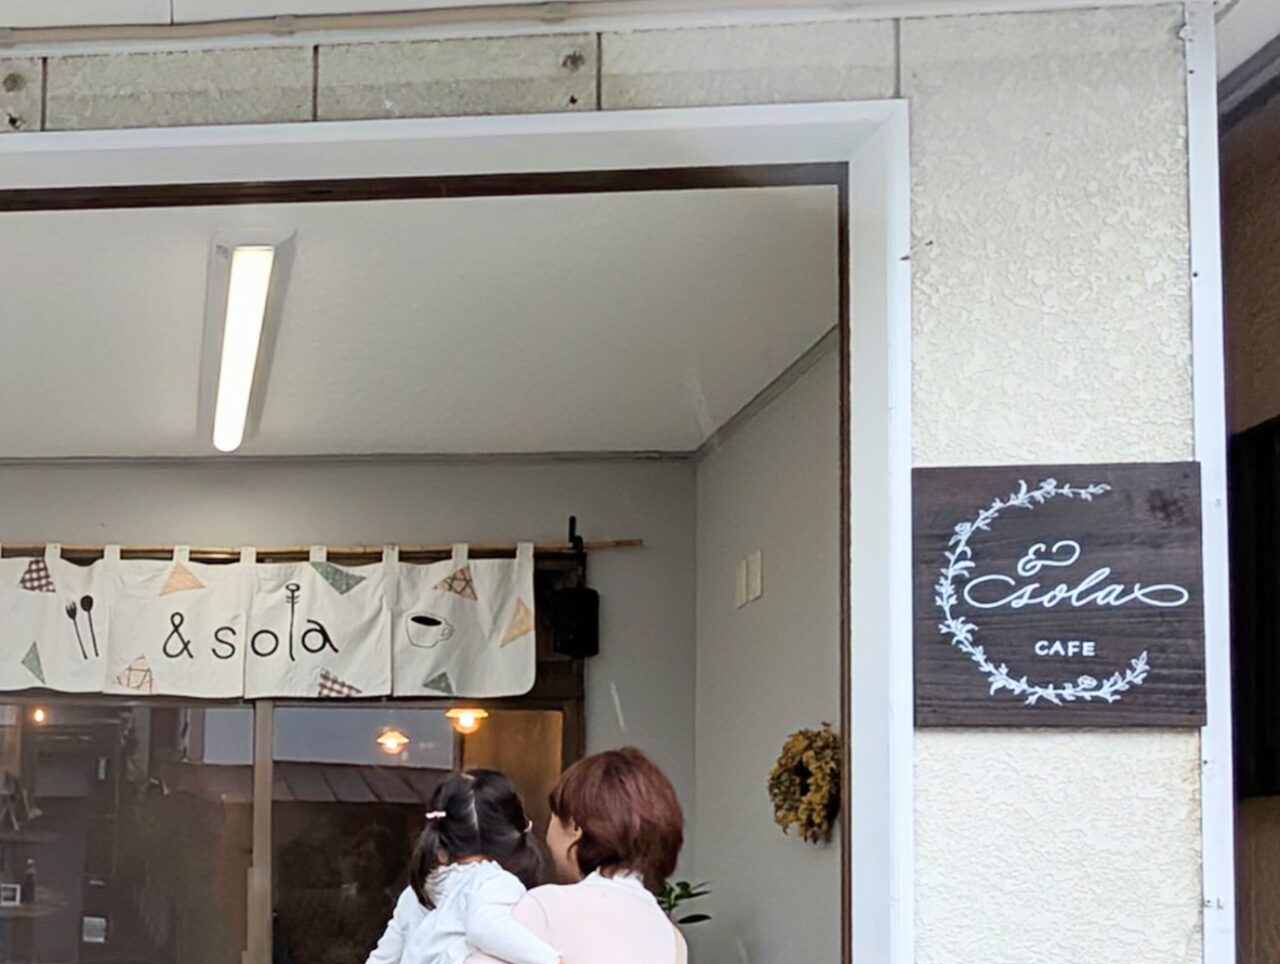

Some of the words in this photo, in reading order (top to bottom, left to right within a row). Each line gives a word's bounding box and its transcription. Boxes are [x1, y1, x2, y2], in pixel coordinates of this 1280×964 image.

[1017, 540, 1080, 576] &
[963, 567, 1189, 609] sola
[162, 611, 194, 660] &
[211, 583, 339, 661] sola
[1034, 641, 1096, 657] CAFE
